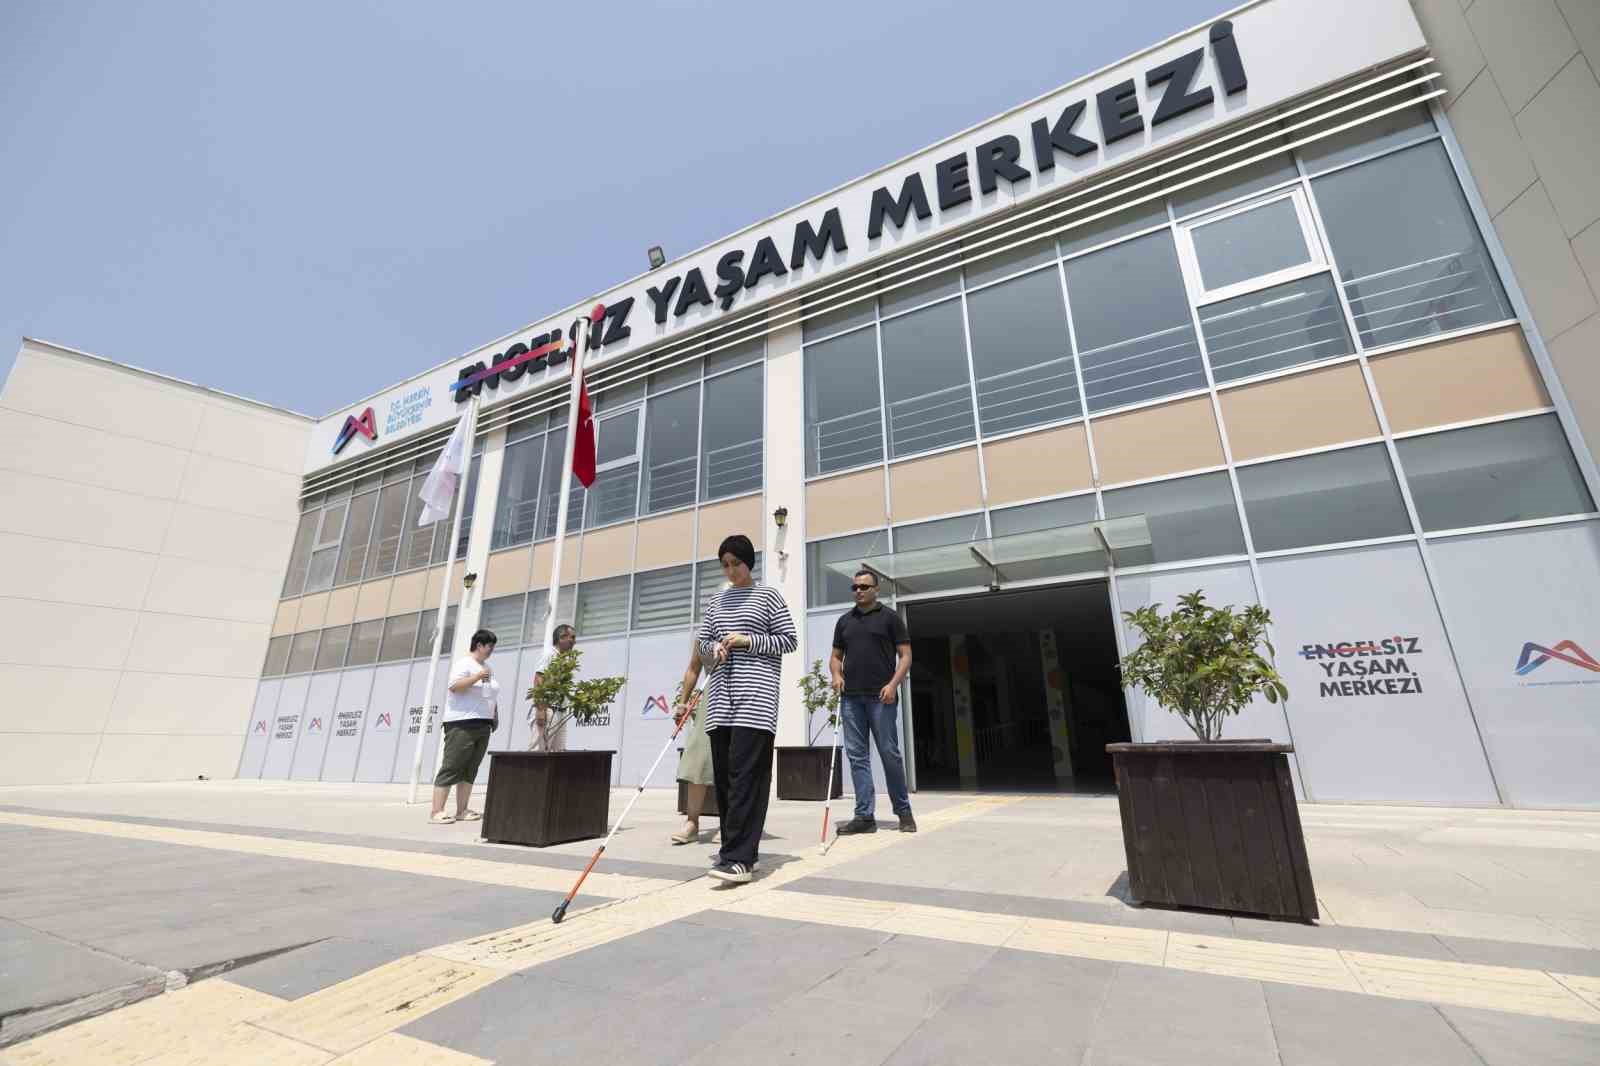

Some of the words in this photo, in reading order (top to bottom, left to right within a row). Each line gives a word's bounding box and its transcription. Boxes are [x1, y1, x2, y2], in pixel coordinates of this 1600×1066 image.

[646, 206, 848, 324] YAŞAM
[867, 20, 1248, 240] MERKEZİ
[1301, 635, 1423, 660] ENGELSİZ
[1319, 658, 1410, 680] YAŞAM
[1319, 672, 1423, 698] MERKEZİ
